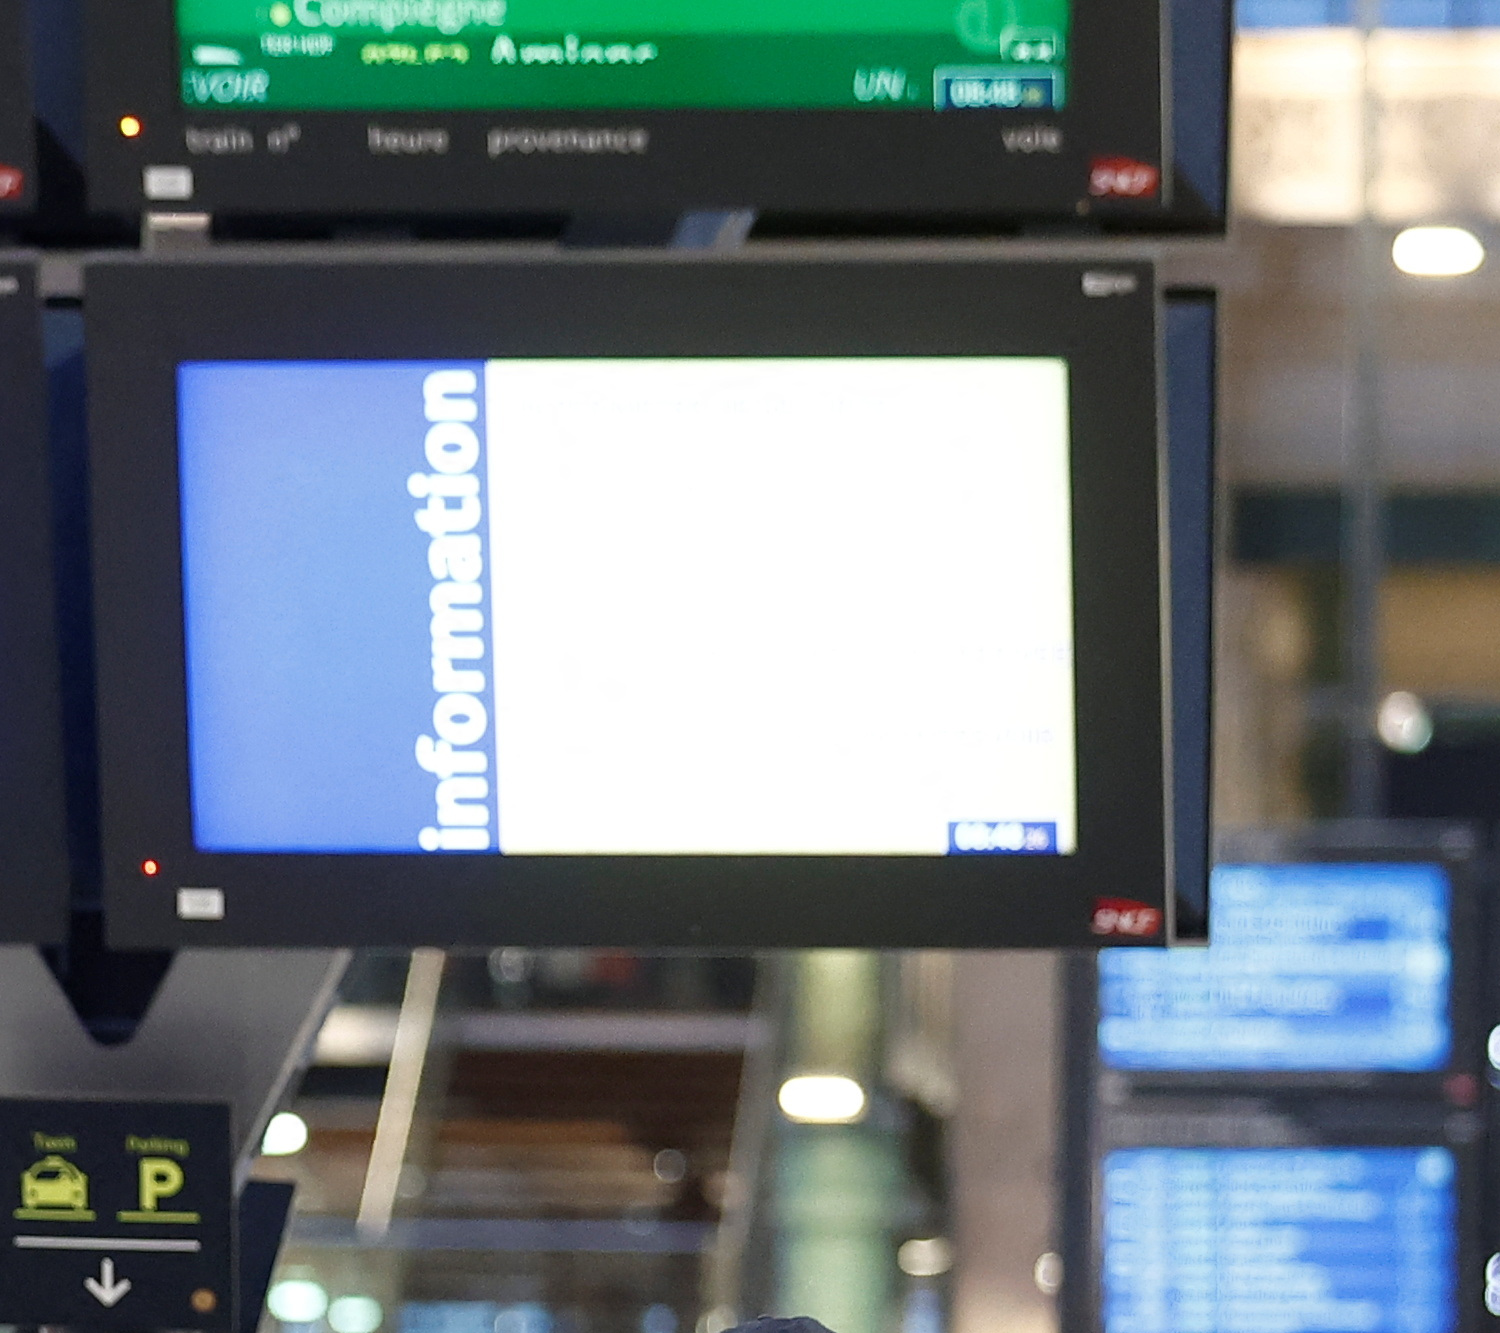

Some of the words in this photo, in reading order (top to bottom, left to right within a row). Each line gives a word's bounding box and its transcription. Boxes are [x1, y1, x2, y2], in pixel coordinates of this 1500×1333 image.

[367, 124, 450, 154] heure
[487, 127, 650, 159] provenance
[406, 366, 493, 854] information
